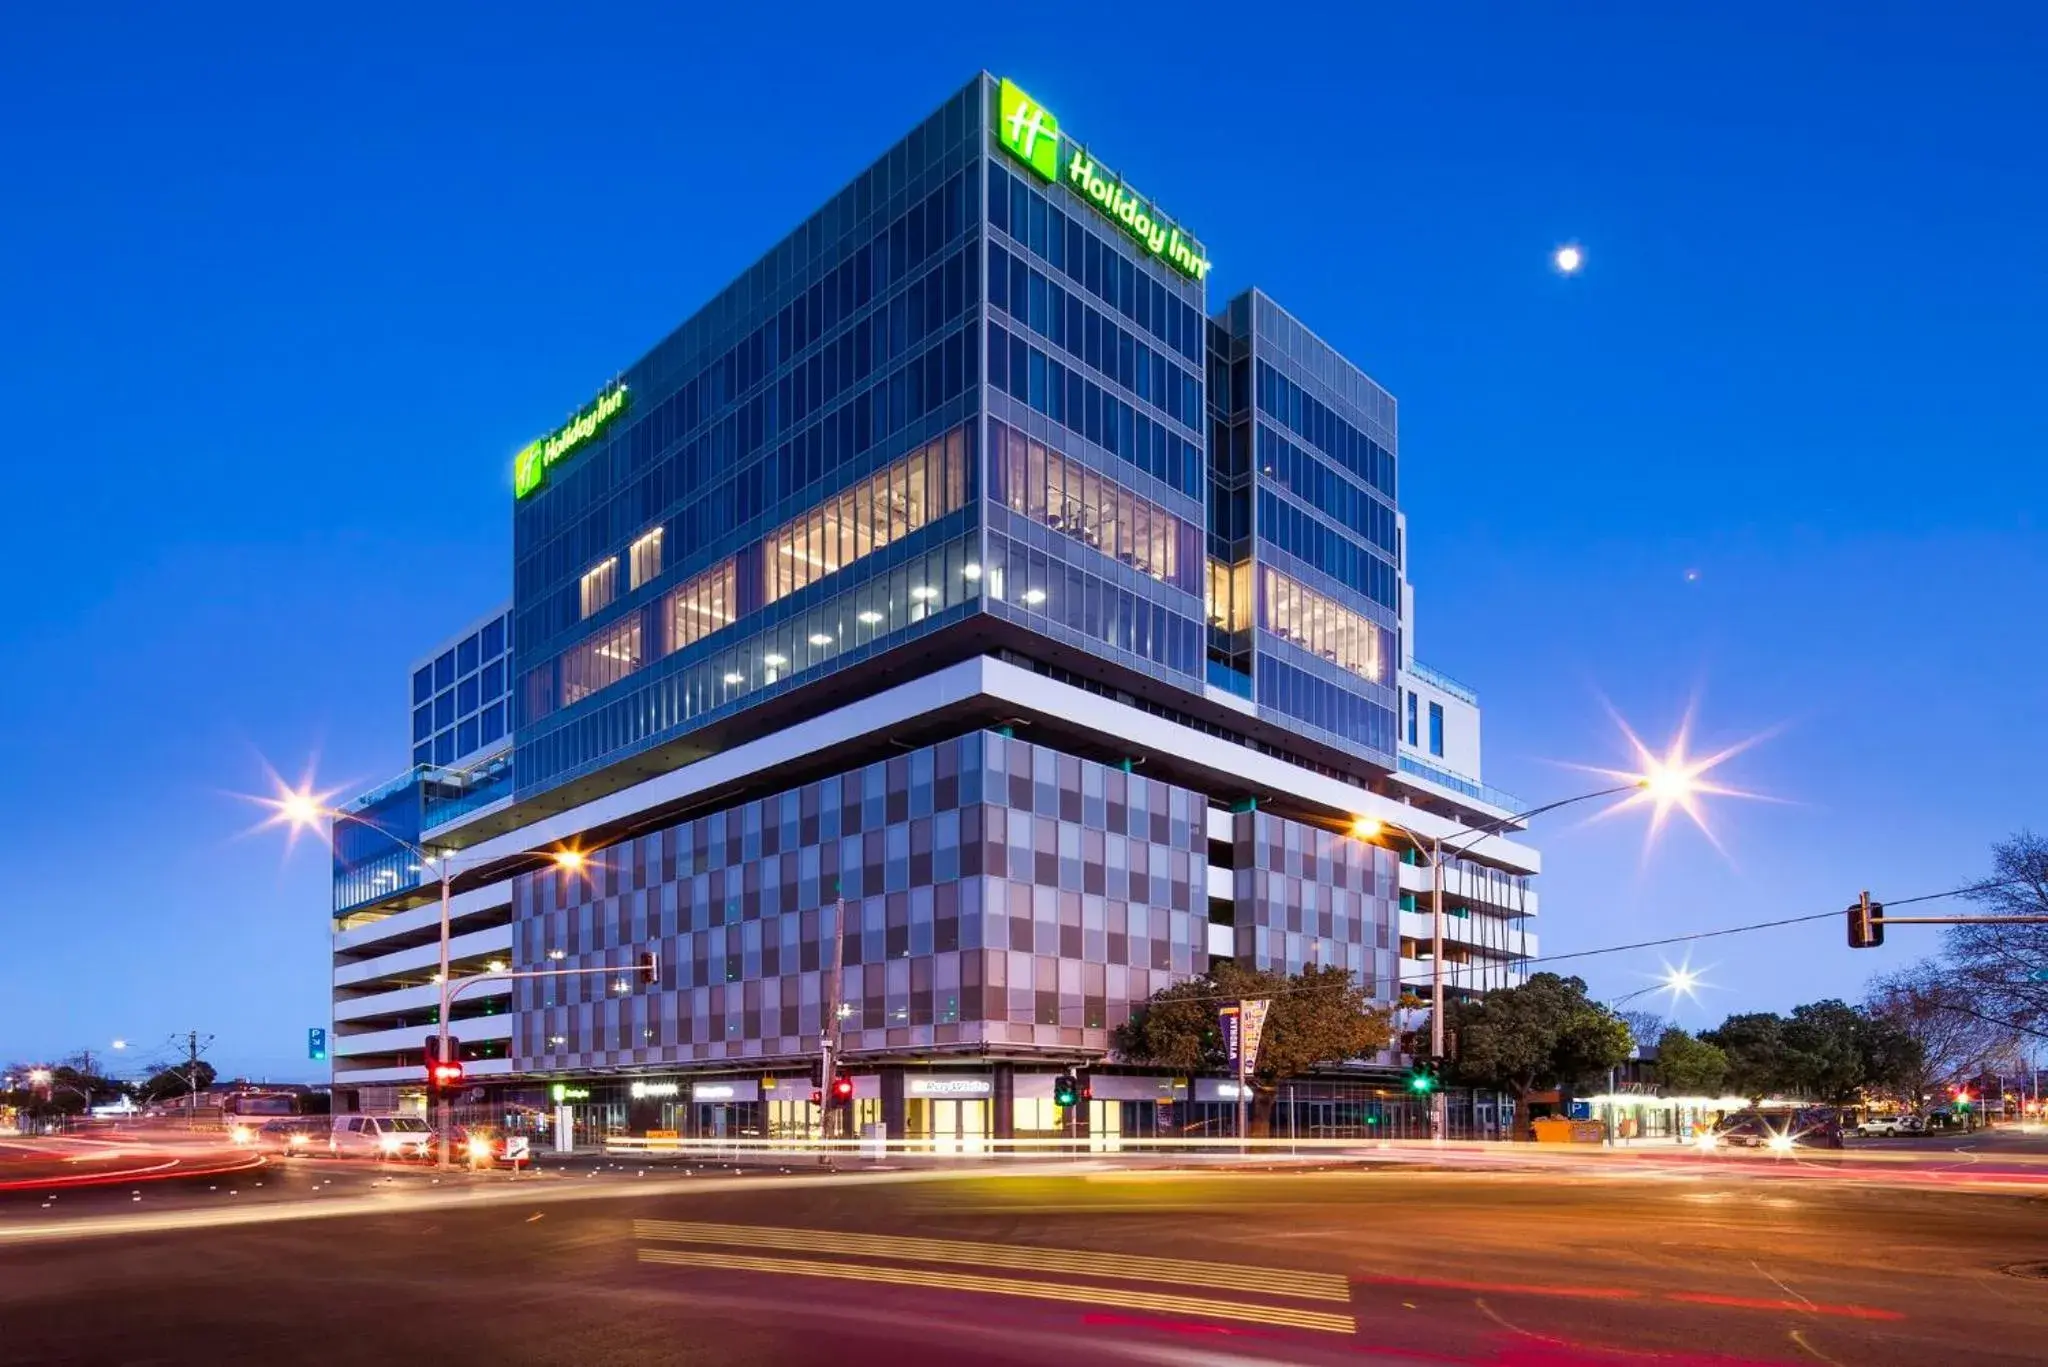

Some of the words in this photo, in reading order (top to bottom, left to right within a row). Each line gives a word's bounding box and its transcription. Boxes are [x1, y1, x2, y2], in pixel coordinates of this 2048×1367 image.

[1069, 151, 1167, 254] Holiday
[1168, 227, 1205, 280] Inn
[543, 410, 598, 467] Holiday
[596, 390, 623, 424] Inn
[311, 1029, 320, 1037] P
[1572, 1103, 1582, 1114] P
